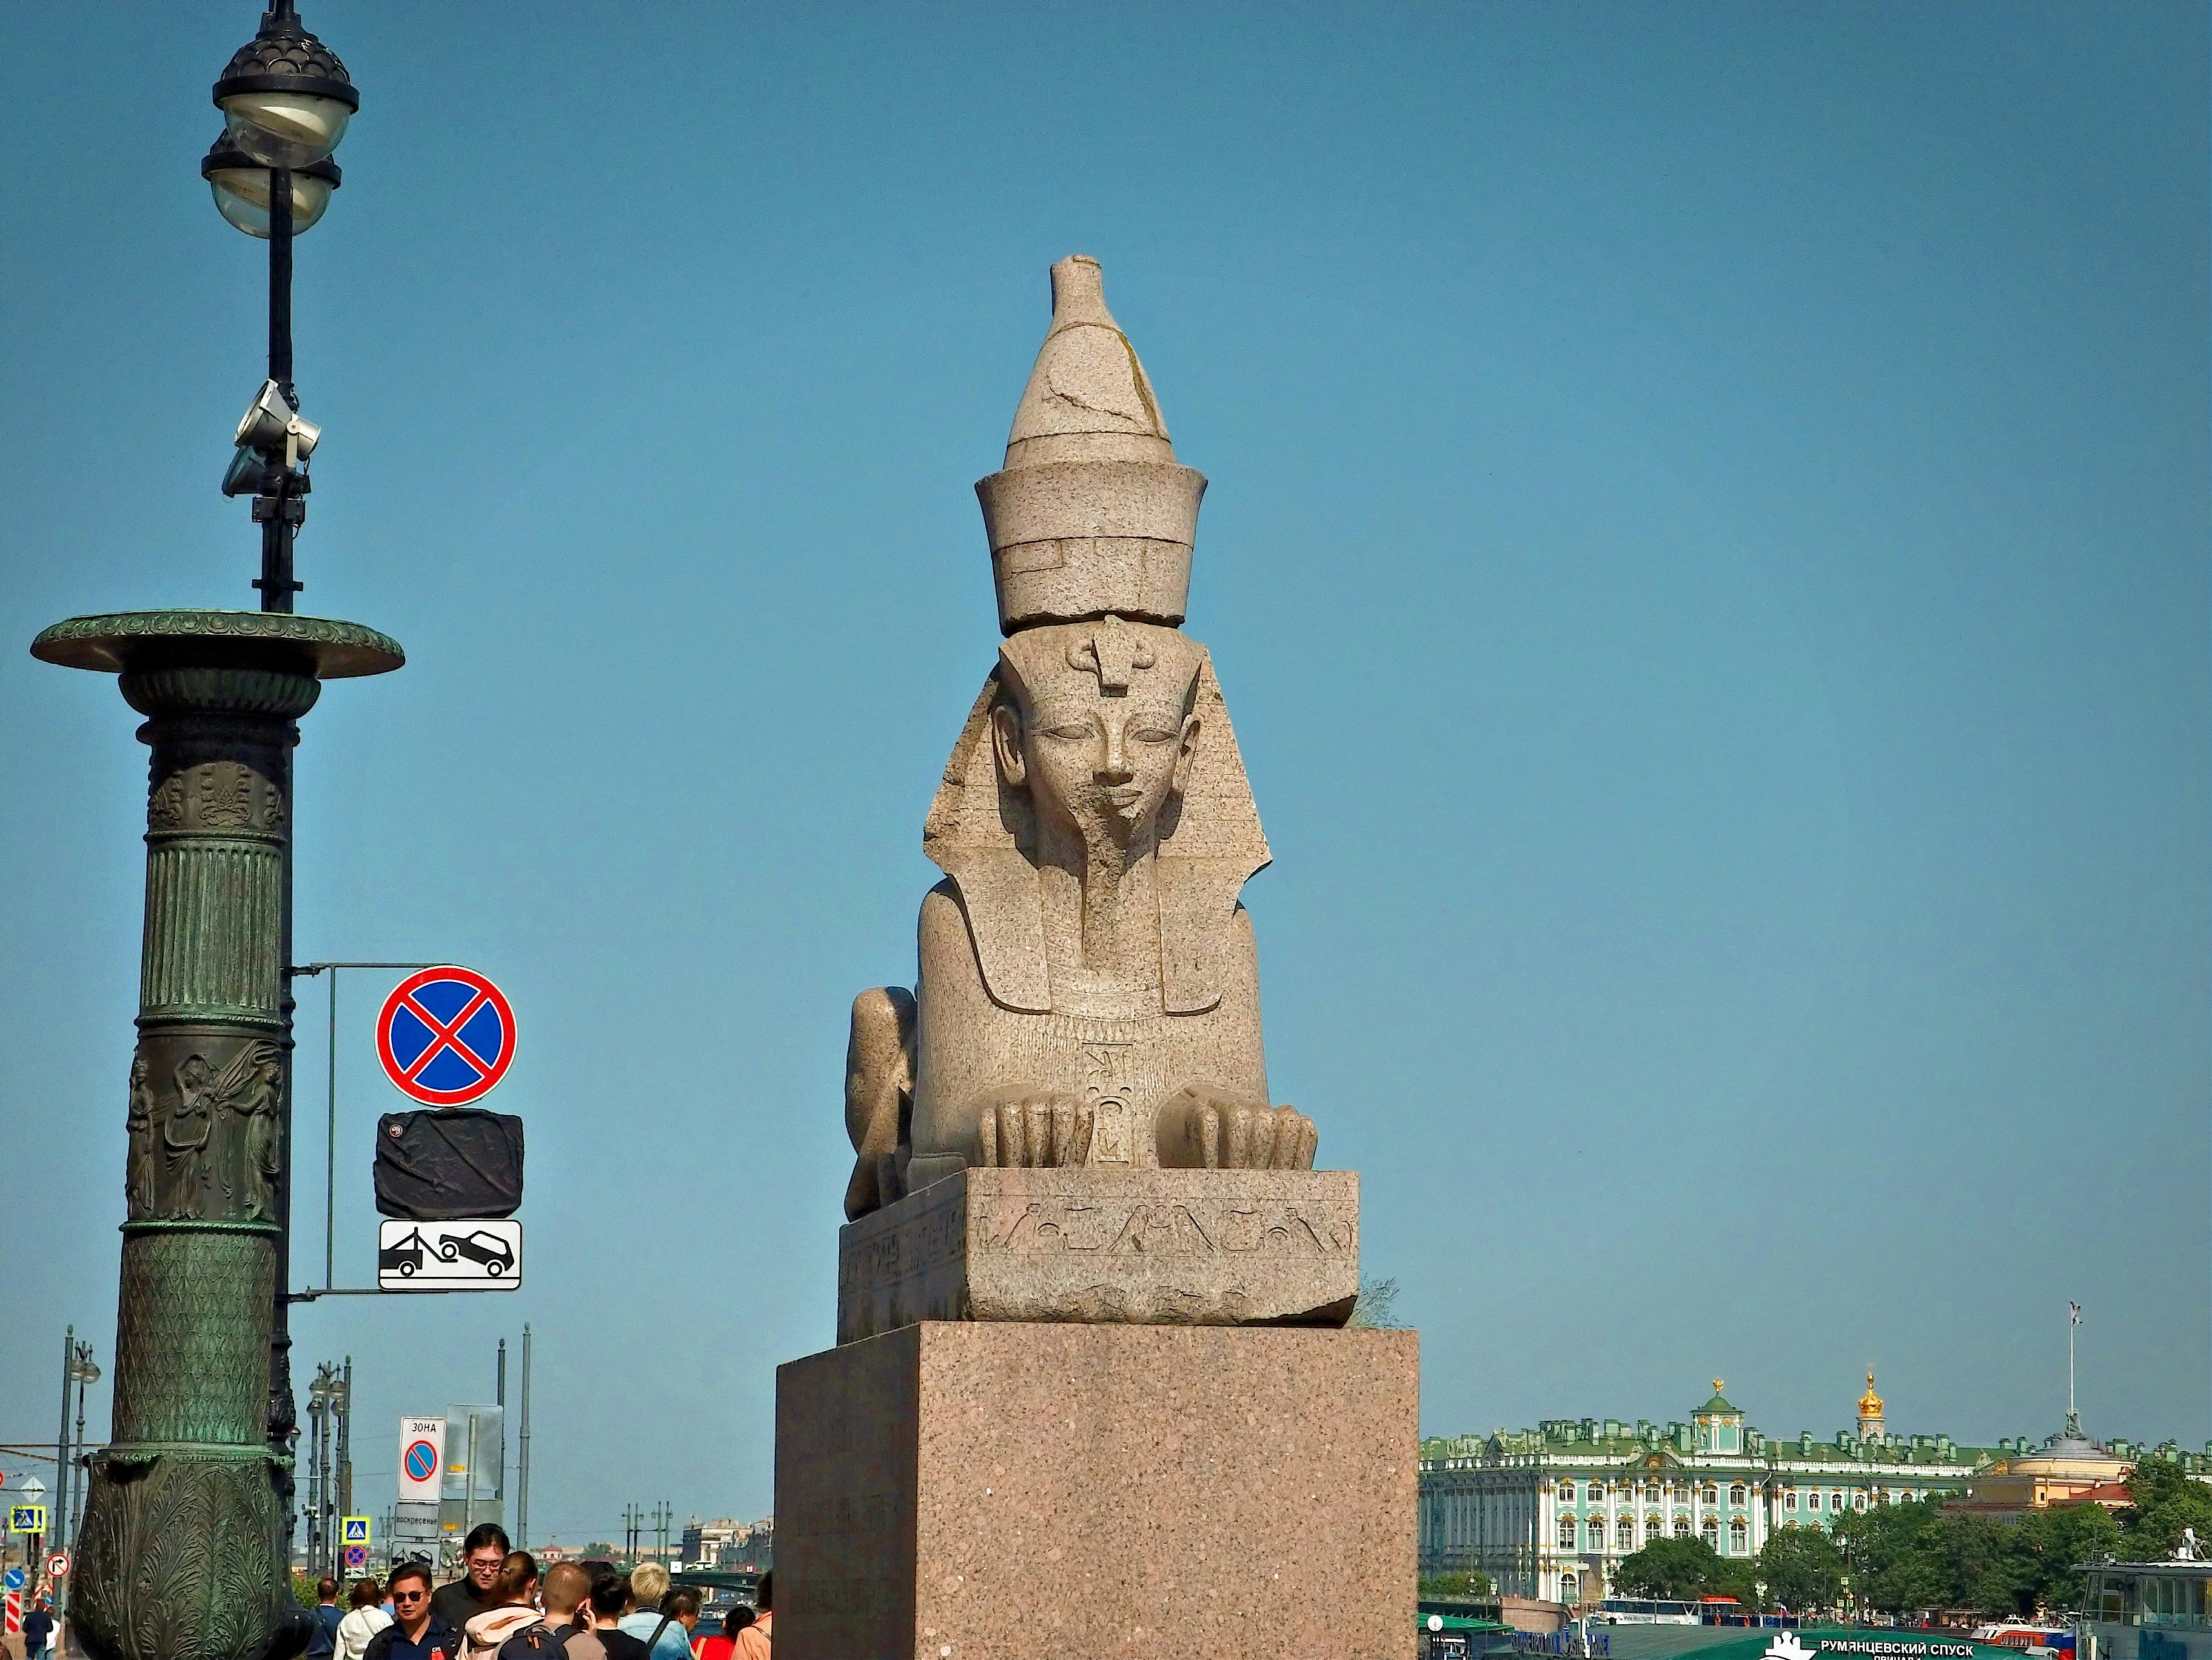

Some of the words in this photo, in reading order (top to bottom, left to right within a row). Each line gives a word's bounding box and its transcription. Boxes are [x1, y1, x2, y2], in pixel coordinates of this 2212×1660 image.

[412, 1423, 436, 1432] ЗОНА
[397, 1516, 437, 1525] воскресенье
[1821, 1640, 1926, 1655] РУМЯНЦЕВСКИЙ
[1931, 1644, 1974, 1656] СПУСК
